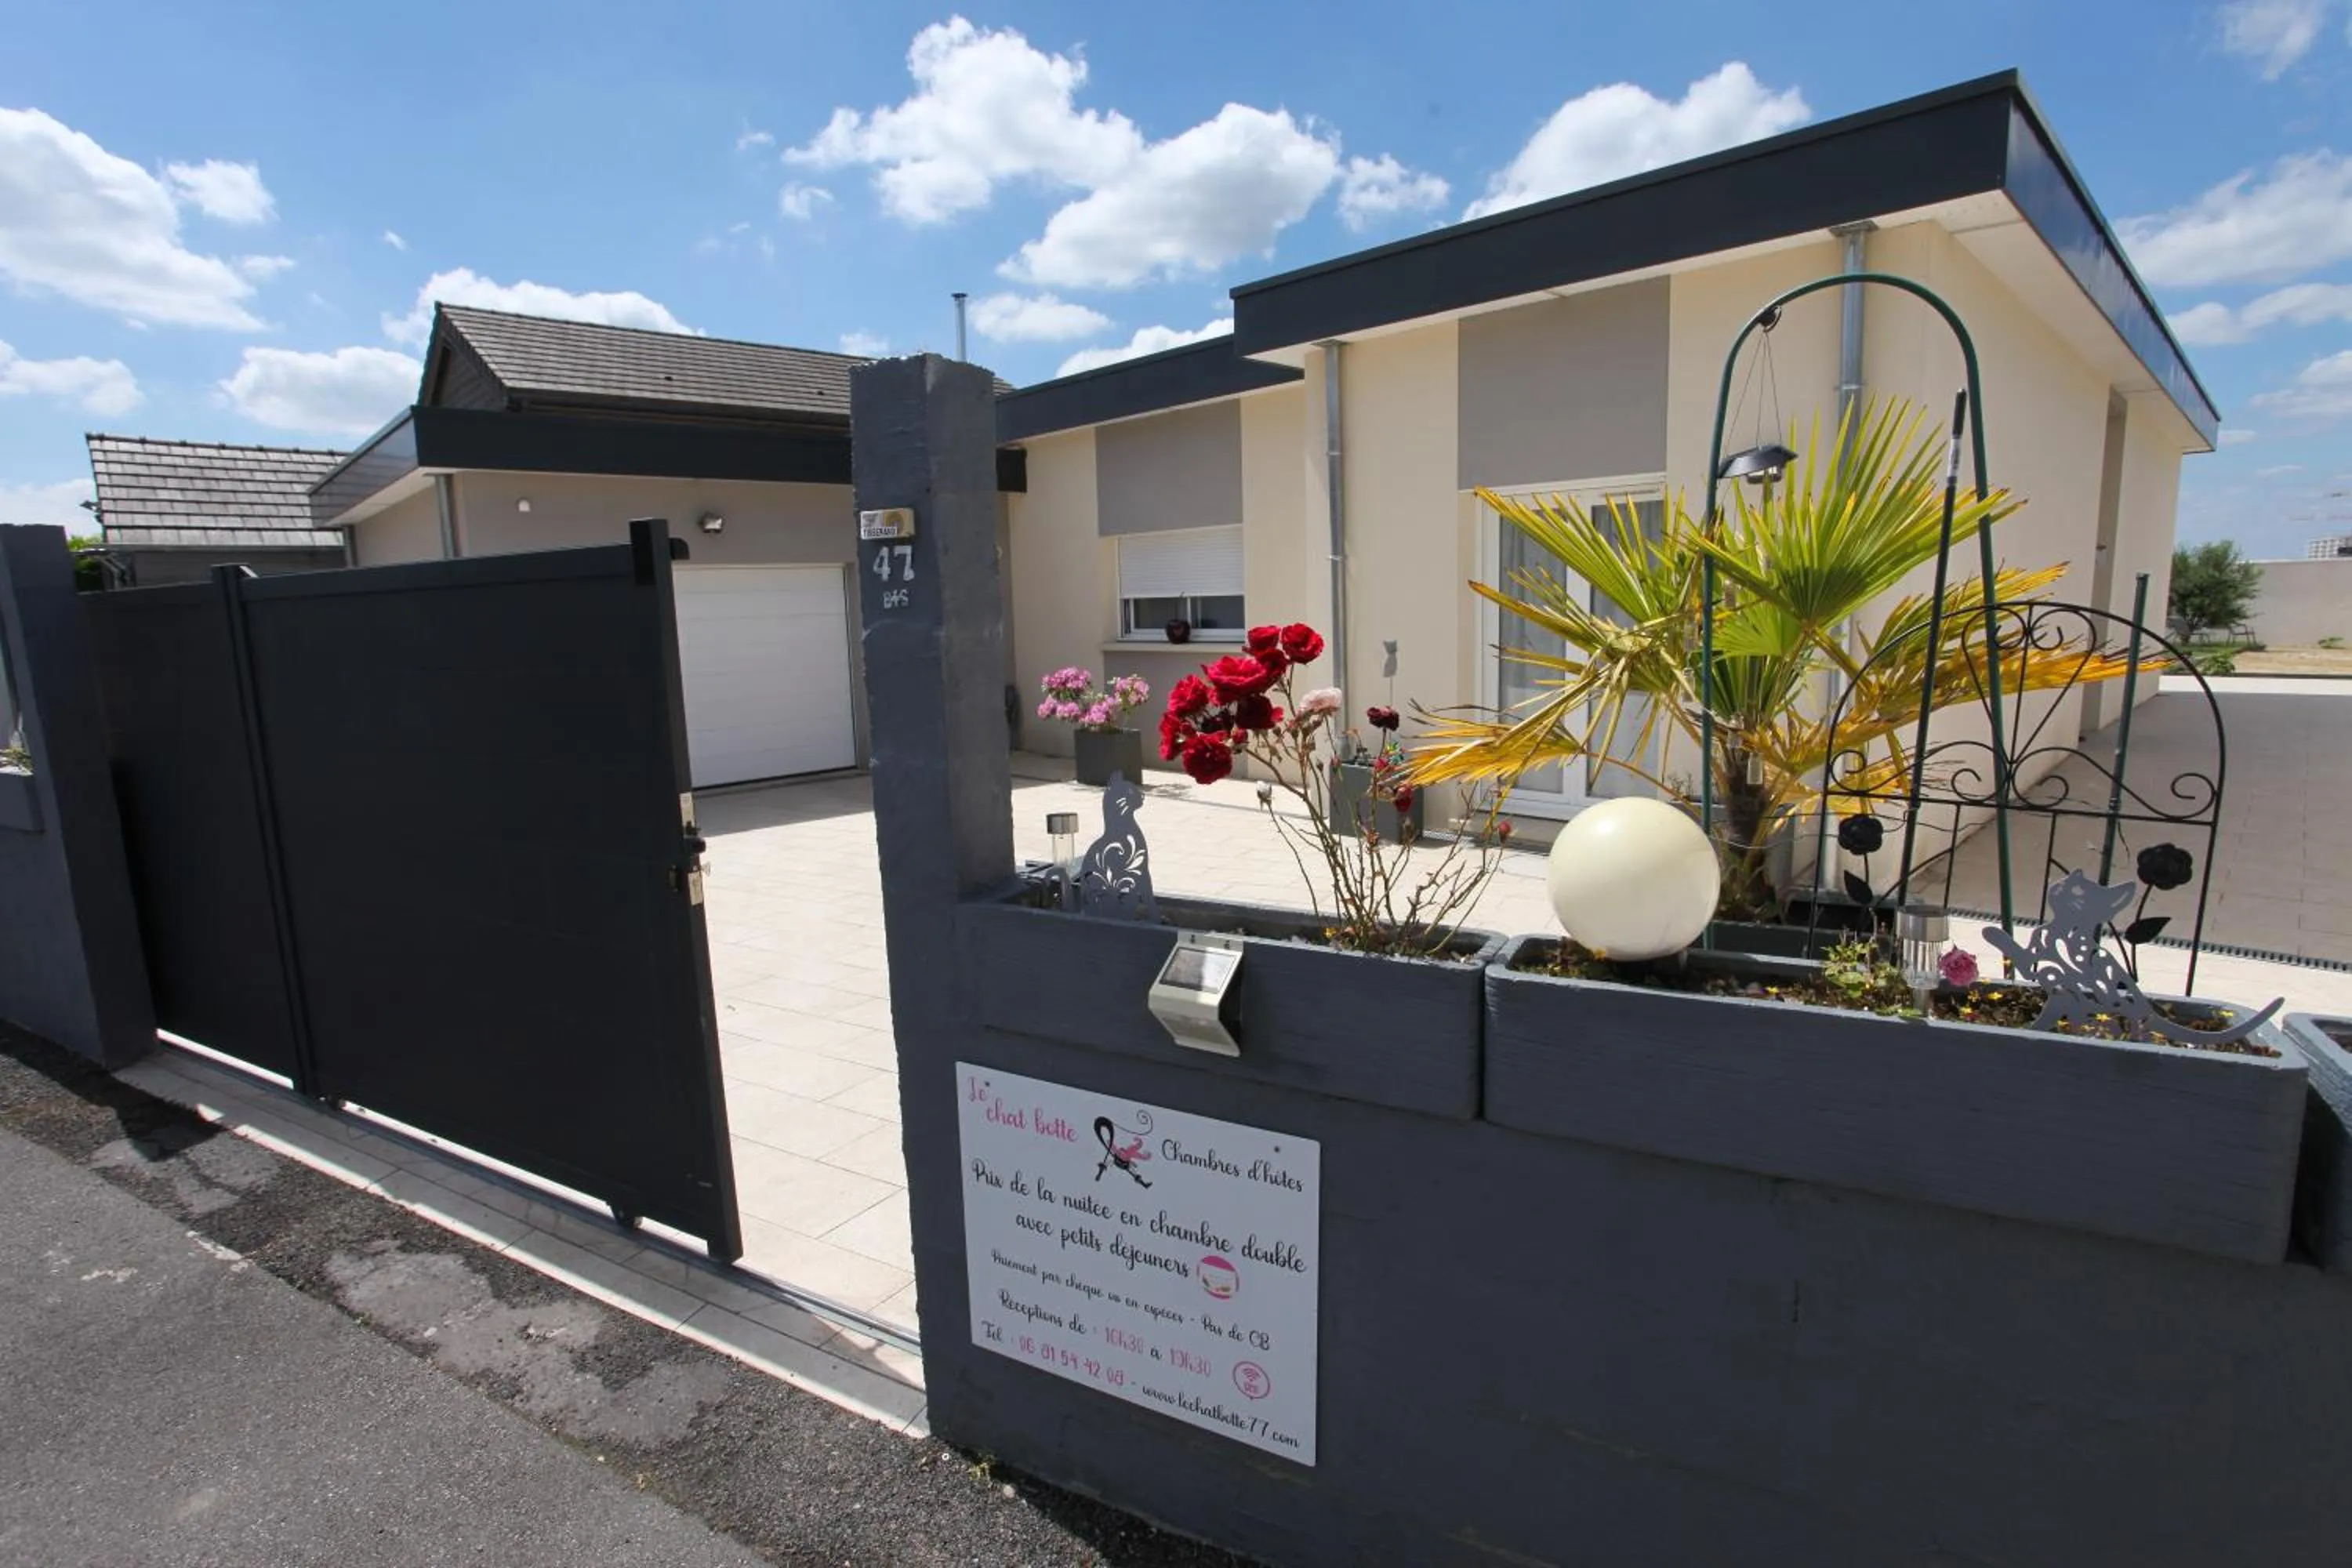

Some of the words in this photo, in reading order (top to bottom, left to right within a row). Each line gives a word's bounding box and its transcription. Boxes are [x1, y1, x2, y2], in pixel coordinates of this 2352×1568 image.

[873, 545, 915, 582] 47
[986, 1098, 1026, 1129] chat
[1161, 1139, 1240, 1177] Chambres
[972, 1158, 1004, 1189] Prix
[1010, 1171, 1029, 1196] de
[1038, 1177, 1057, 1203] la
[1120, 1210, 1142, 1226] en
[1150, 1210, 1234, 1253] chambre
[1241, 1233, 1308, 1273] double
[1016, 1214, 1054, 1236] avec
[1061, 1226, 1102, 1251] petits
[1042, 1271, 1062, 1284] par
[1125, 1297, 1141, 1308] en
[1229, 1323, 1245, 1342] de
[1249, 1330, 1270, 1351] CB
[1069, 1313, 1087, 1334] de
[1083, 1357, 1102, 1378] 42
